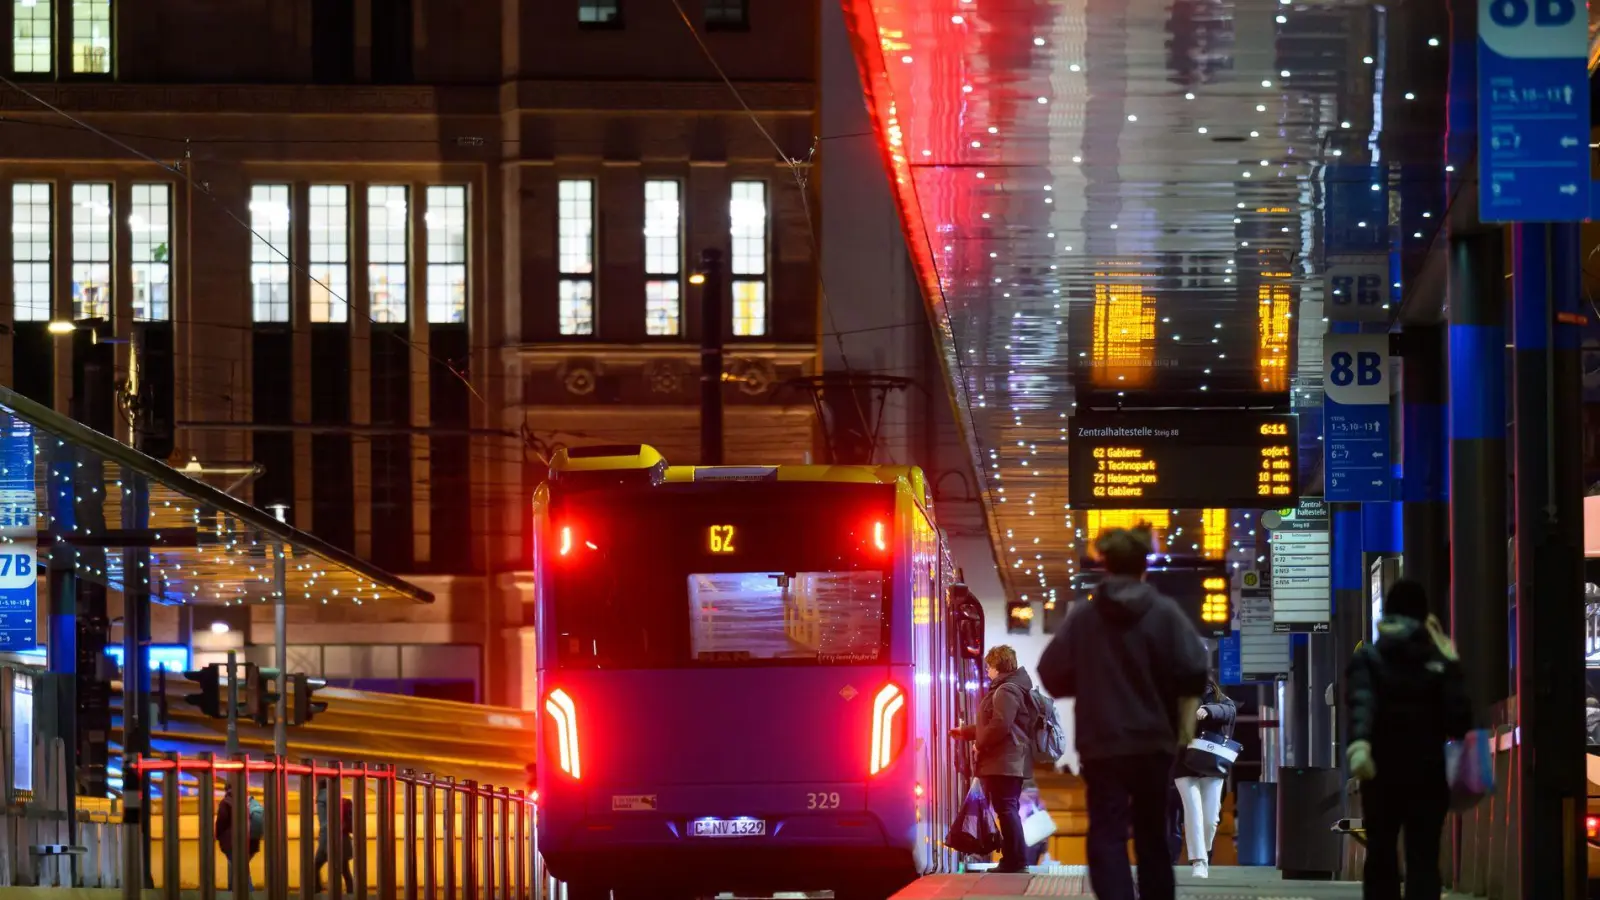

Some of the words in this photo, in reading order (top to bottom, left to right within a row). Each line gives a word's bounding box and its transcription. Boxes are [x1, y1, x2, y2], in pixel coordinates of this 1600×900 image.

[1330, 352, 1382, 387] 8B
[1078, 427, 1153, 437] Zentralhaltestelle
[1154, 429, 1170, 437] Steig
[1260, 424, 1287, 435] 6:11
[1093, 448, 1105, 458] 62
[1107, 447, 1142, 458] Gablenz
[1261, 446, 1290, 458] sofort
[1098, 461, 1105, 470] 3
[1107, 460, 1156, 472] Technopark
[1262, 459, 1270, 469] 6
[1272, 459, 1290, 469] min
[1093, 473, 1105, 483] 72
[1107, 473, 1157, 485] Heimgarten
[1259, 472, 1270, 482] 10
[1272, 472, 1290, 482] min
[1331, 478, 1338, 488] 9
[1093, 486, 1105, 496] 62
[1107, 486, 1142, 496] Gablenz
[1258, 485, 1270, 495] 20
[1272, 485, 1290, 495] min
[1300, 501, 1322, 509] Zentral-
[1297, 509, 1327, 517] haltestelle
[709, 524, 735, 552] 62
[0, 554, 31, 577] 7B
[806, 793, 841, 809] 329
[712, 822, 730, 835] NV
[731, 821, 765, 835] 1329
